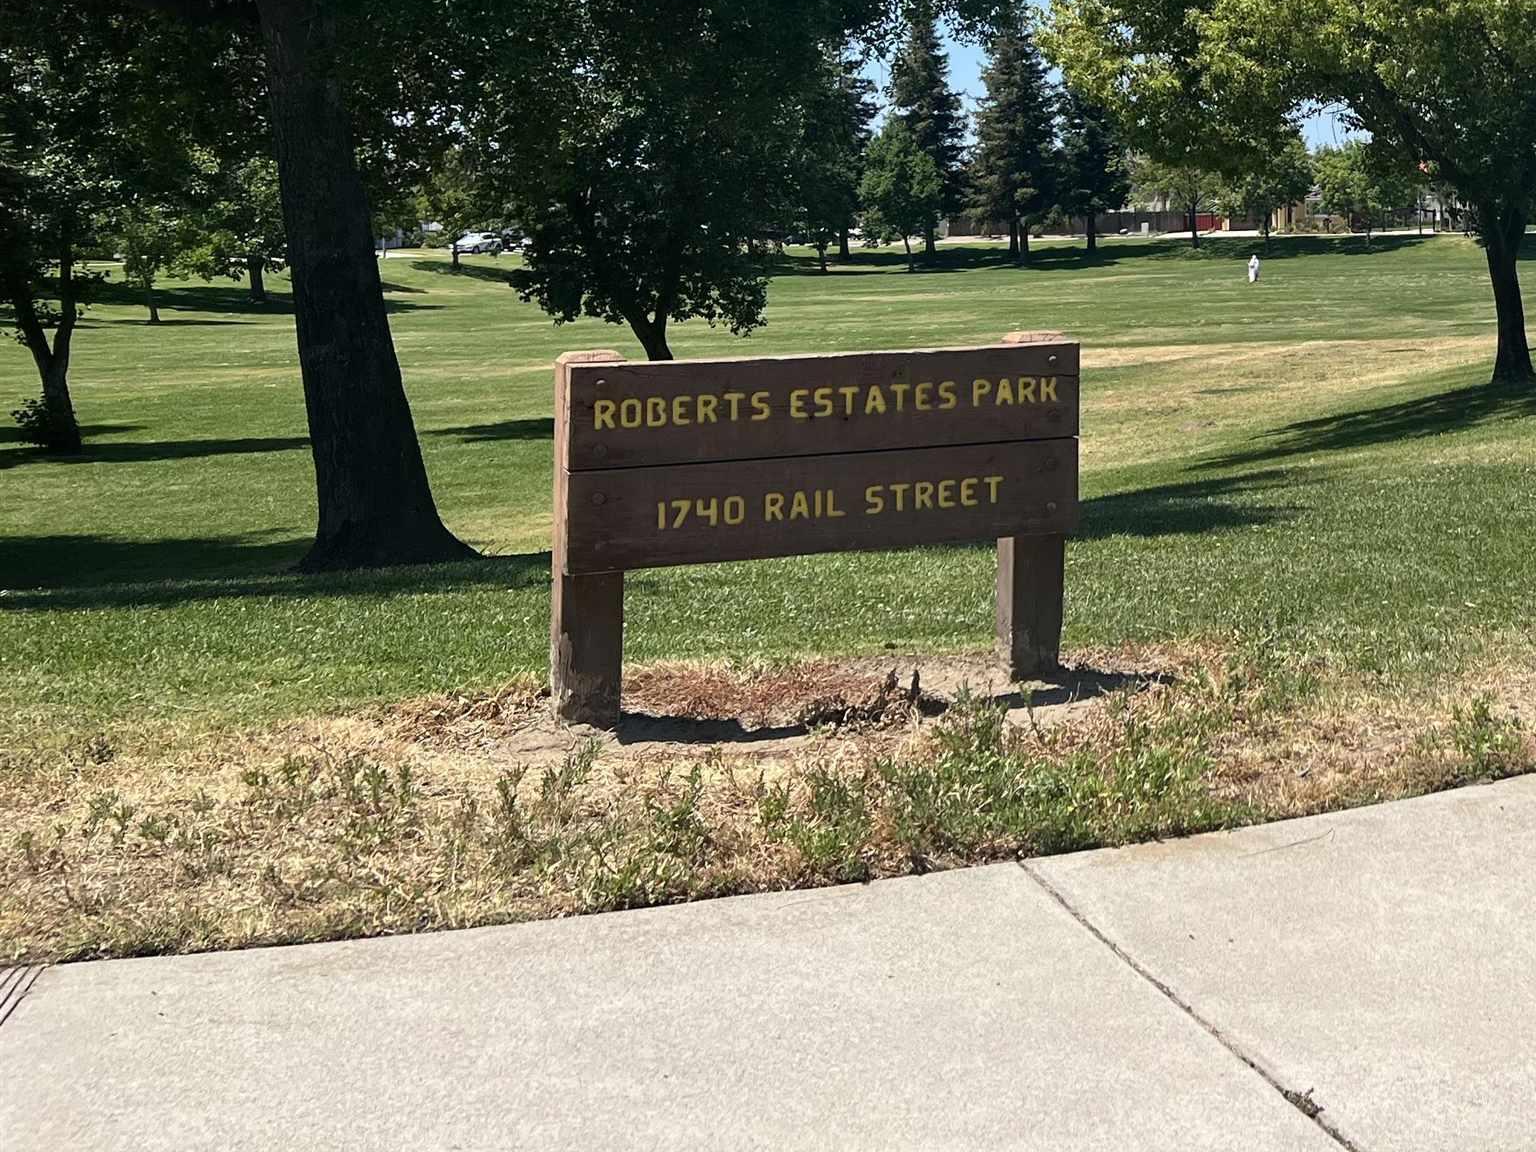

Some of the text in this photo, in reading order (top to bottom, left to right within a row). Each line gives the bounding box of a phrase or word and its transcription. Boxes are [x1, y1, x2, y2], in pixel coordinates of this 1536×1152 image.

[593, 376, 1058, 430] ROBERTS ESTATES PARK
[657, 476, 1004, 530] 1740 RAIL STREET
